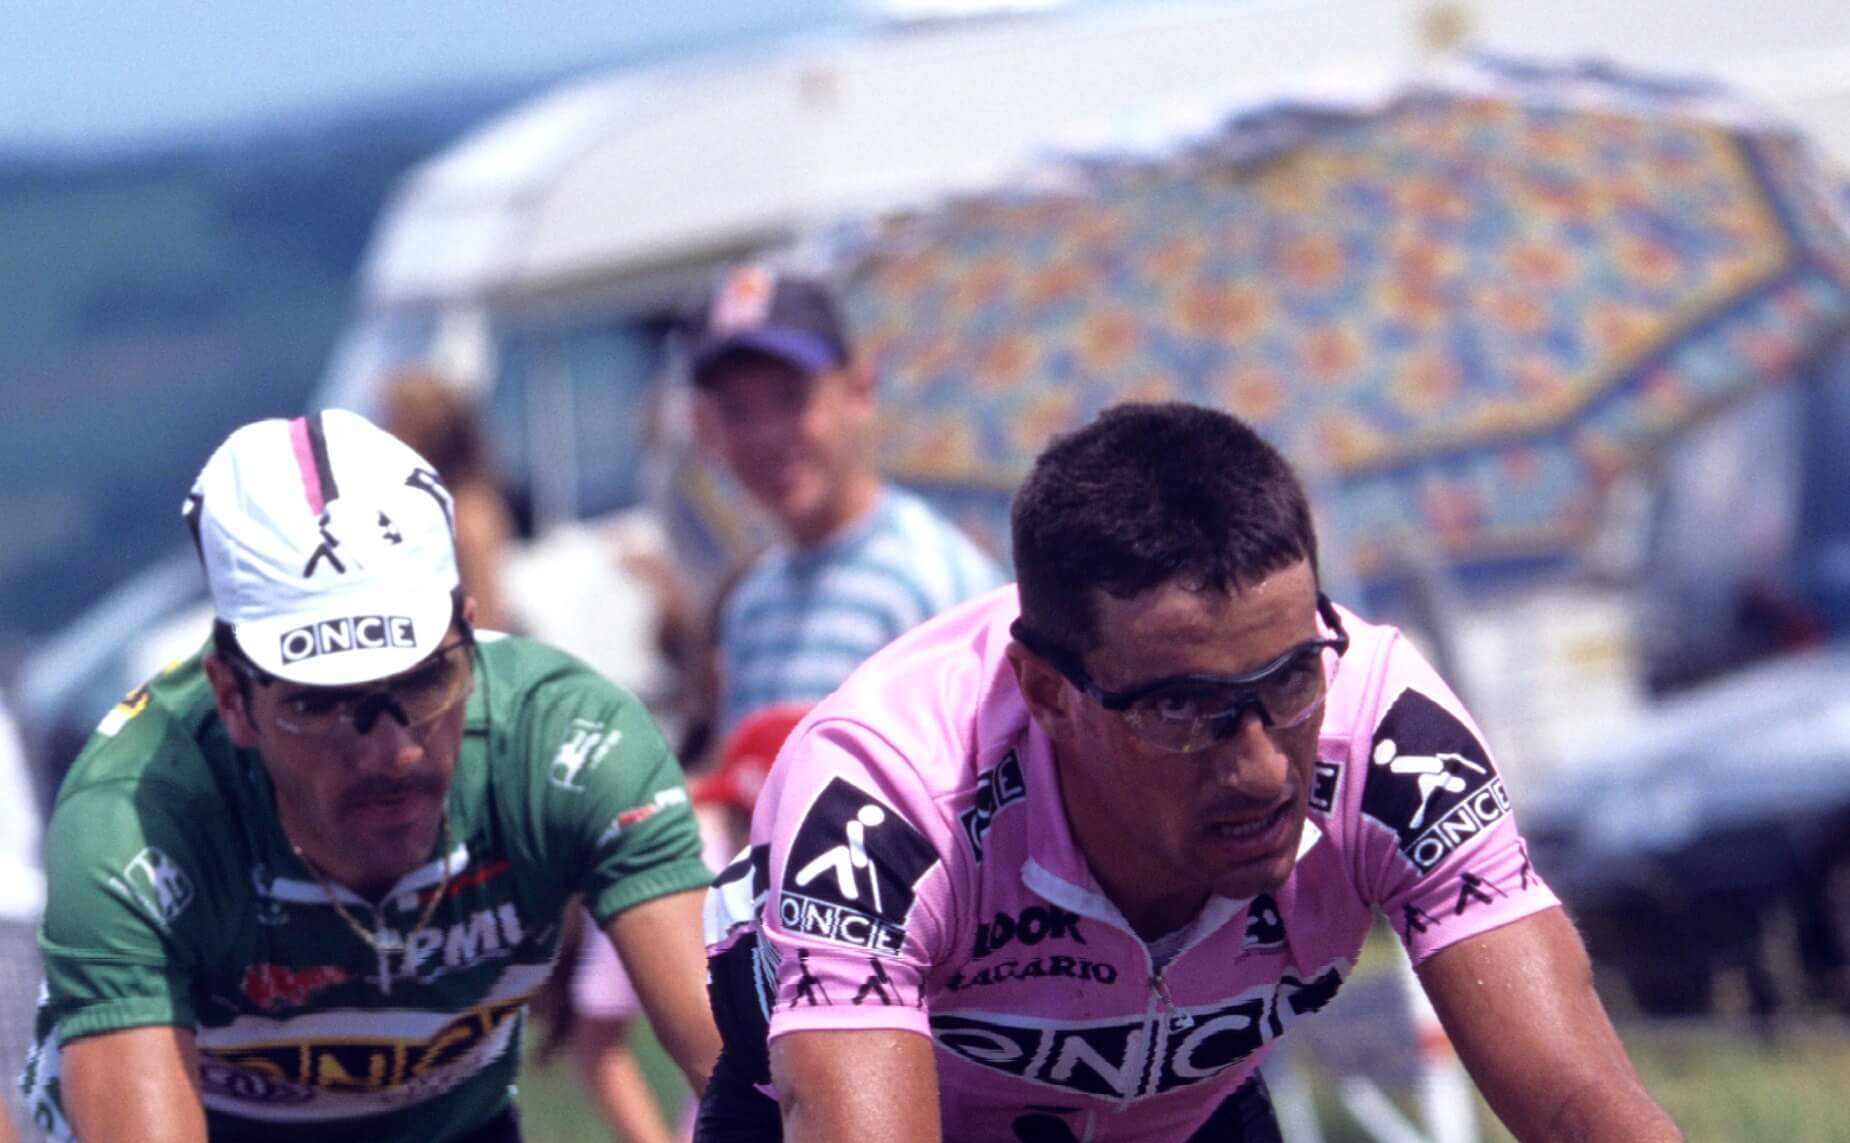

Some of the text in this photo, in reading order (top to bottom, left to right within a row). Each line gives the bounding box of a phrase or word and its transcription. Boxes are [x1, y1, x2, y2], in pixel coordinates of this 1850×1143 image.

[280, 615, 417, 665] ONCE
[778, 895, 905, 955] ONCE
[972, 900, 1087, 960] LOOK
